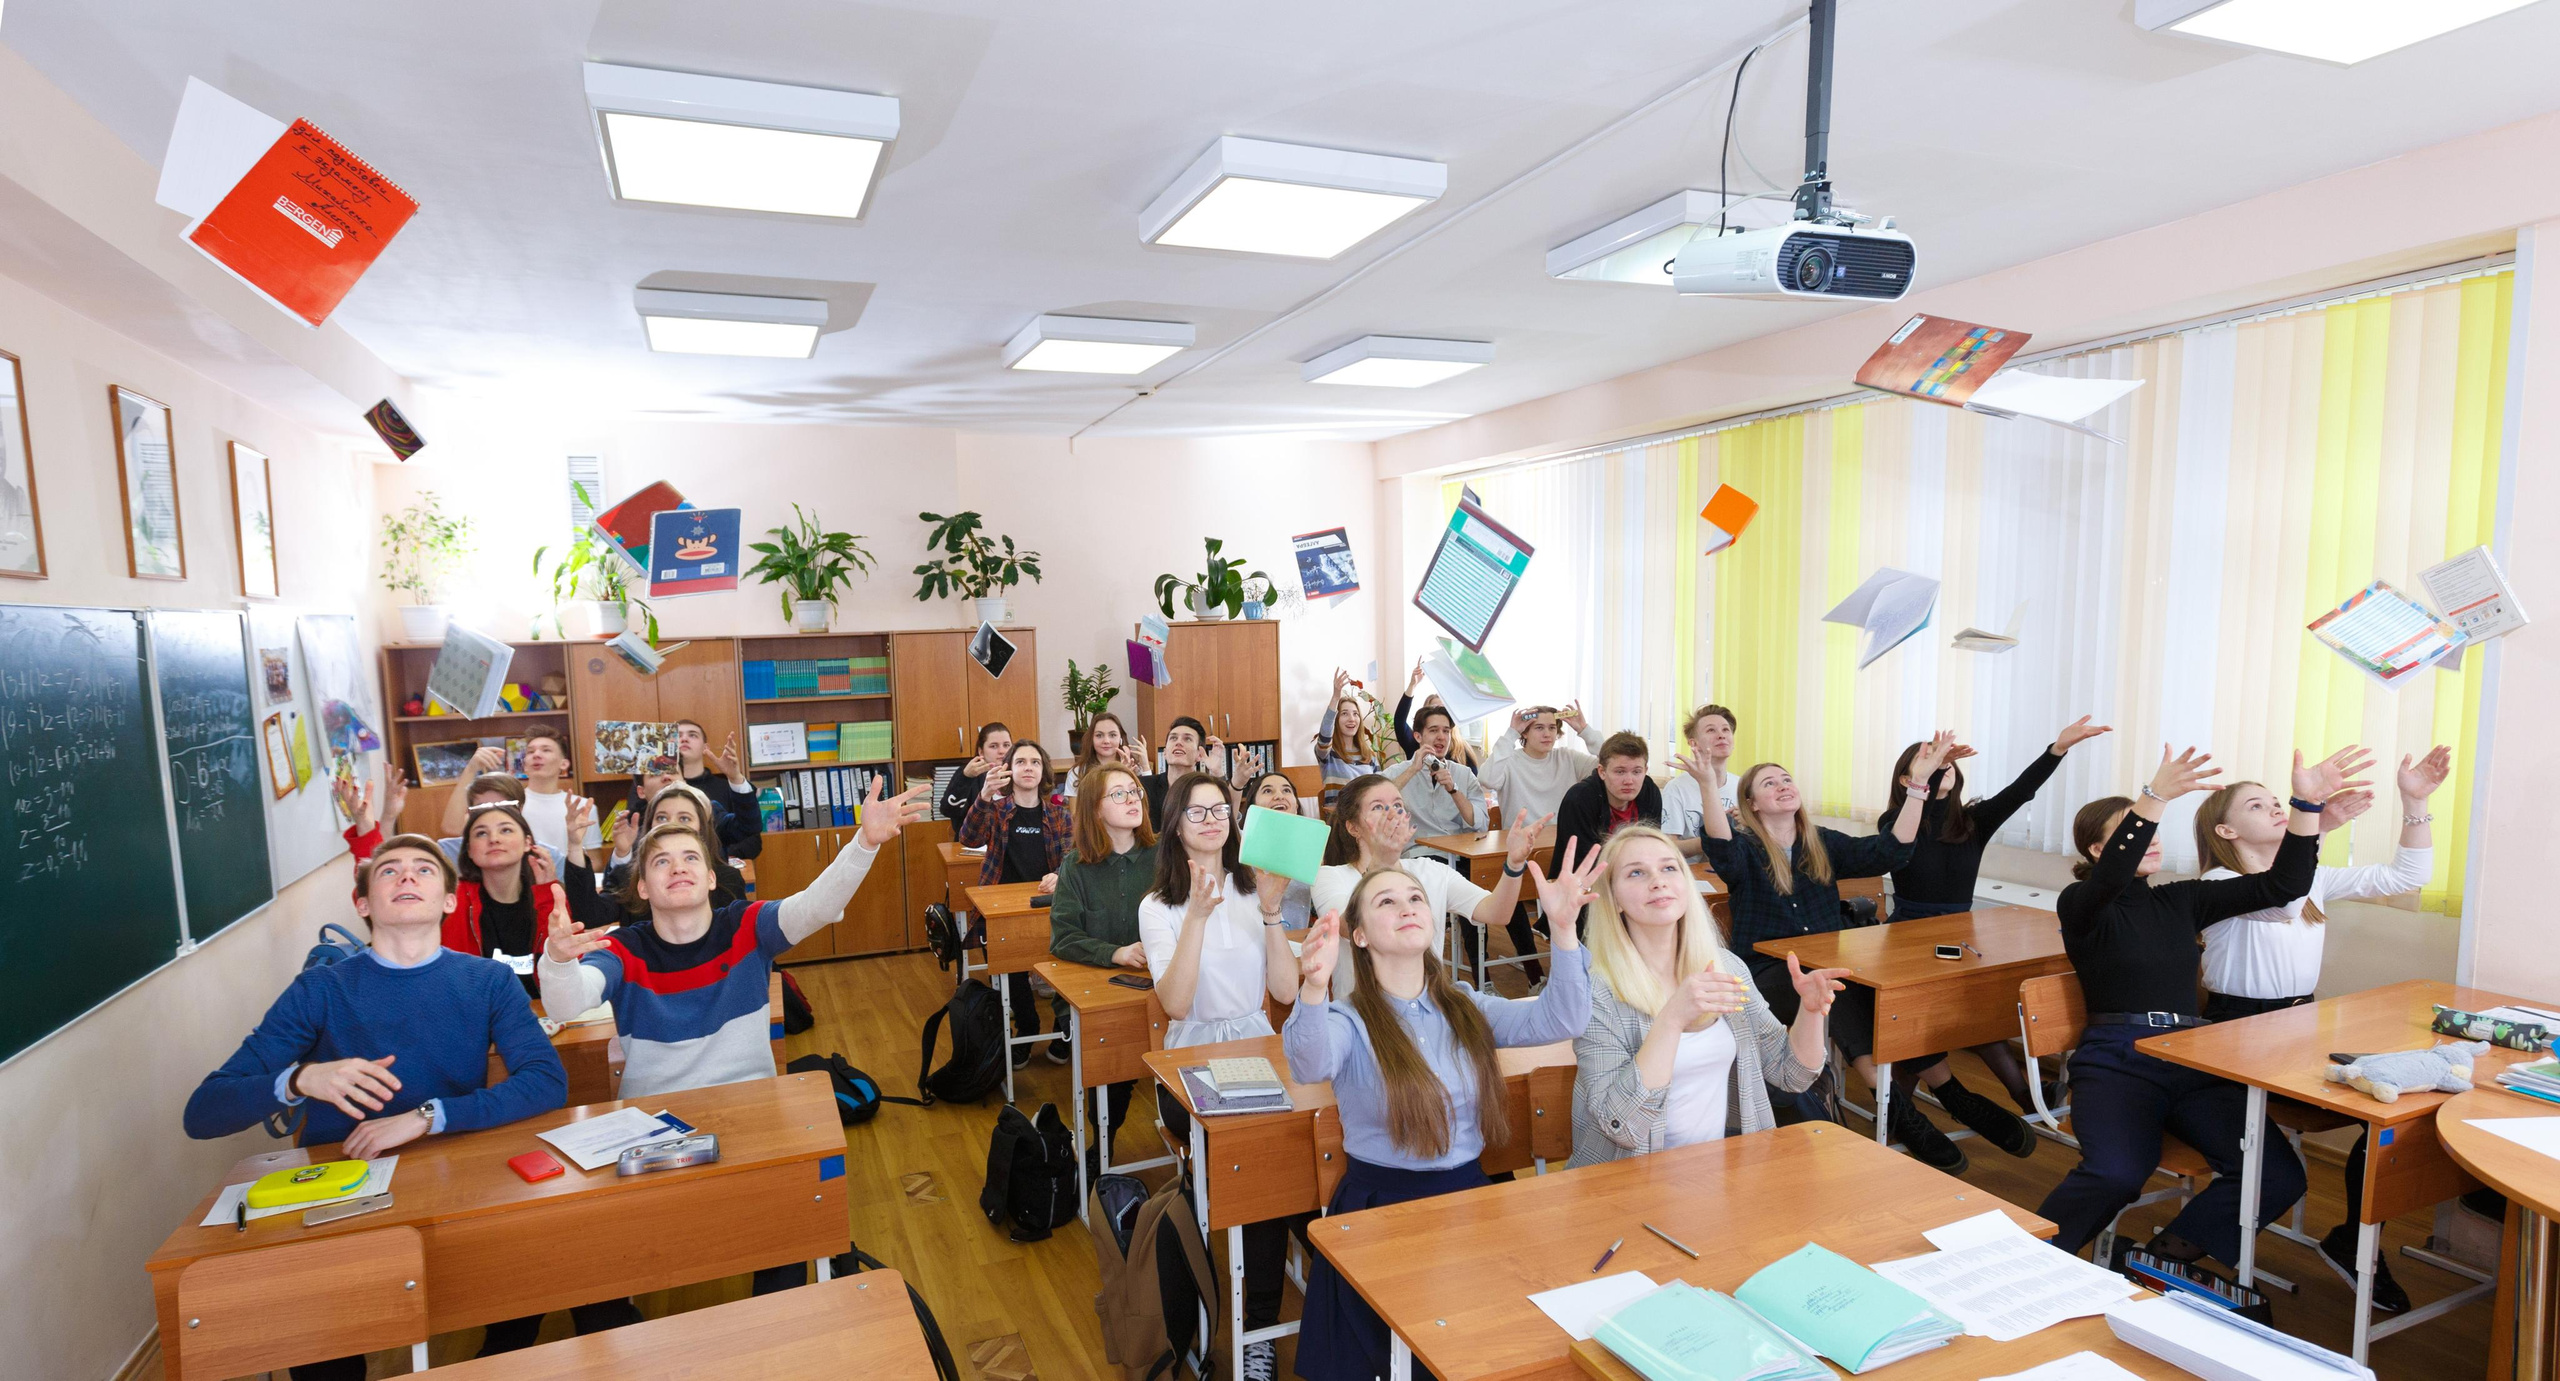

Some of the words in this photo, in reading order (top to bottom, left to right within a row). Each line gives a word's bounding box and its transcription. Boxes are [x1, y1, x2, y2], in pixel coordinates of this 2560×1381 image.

[275, 195, 331, 236] BERGEN
[1295, 540, 1319, 549] АЛГЕБРА
[676, 1156, 693, 1164] TRIP
